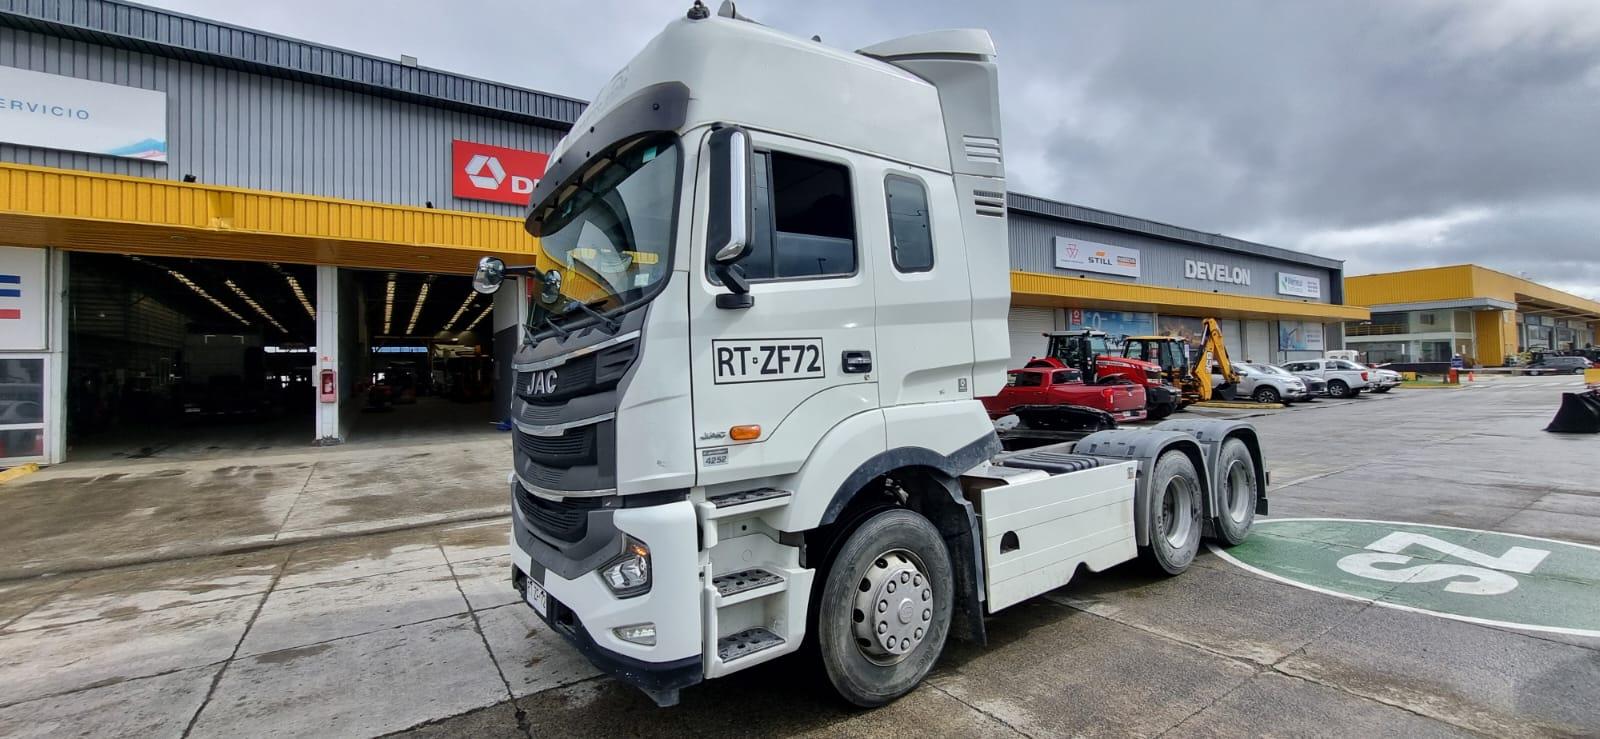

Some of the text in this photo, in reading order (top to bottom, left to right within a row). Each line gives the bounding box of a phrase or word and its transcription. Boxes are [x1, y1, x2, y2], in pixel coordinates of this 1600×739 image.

[1088, 256, 1113, 266] STILL
[1185, 259, 1251, 286] DEVELON
[527, 370, 558, 395] JAC
[705, 455, 727, 465] 4252
